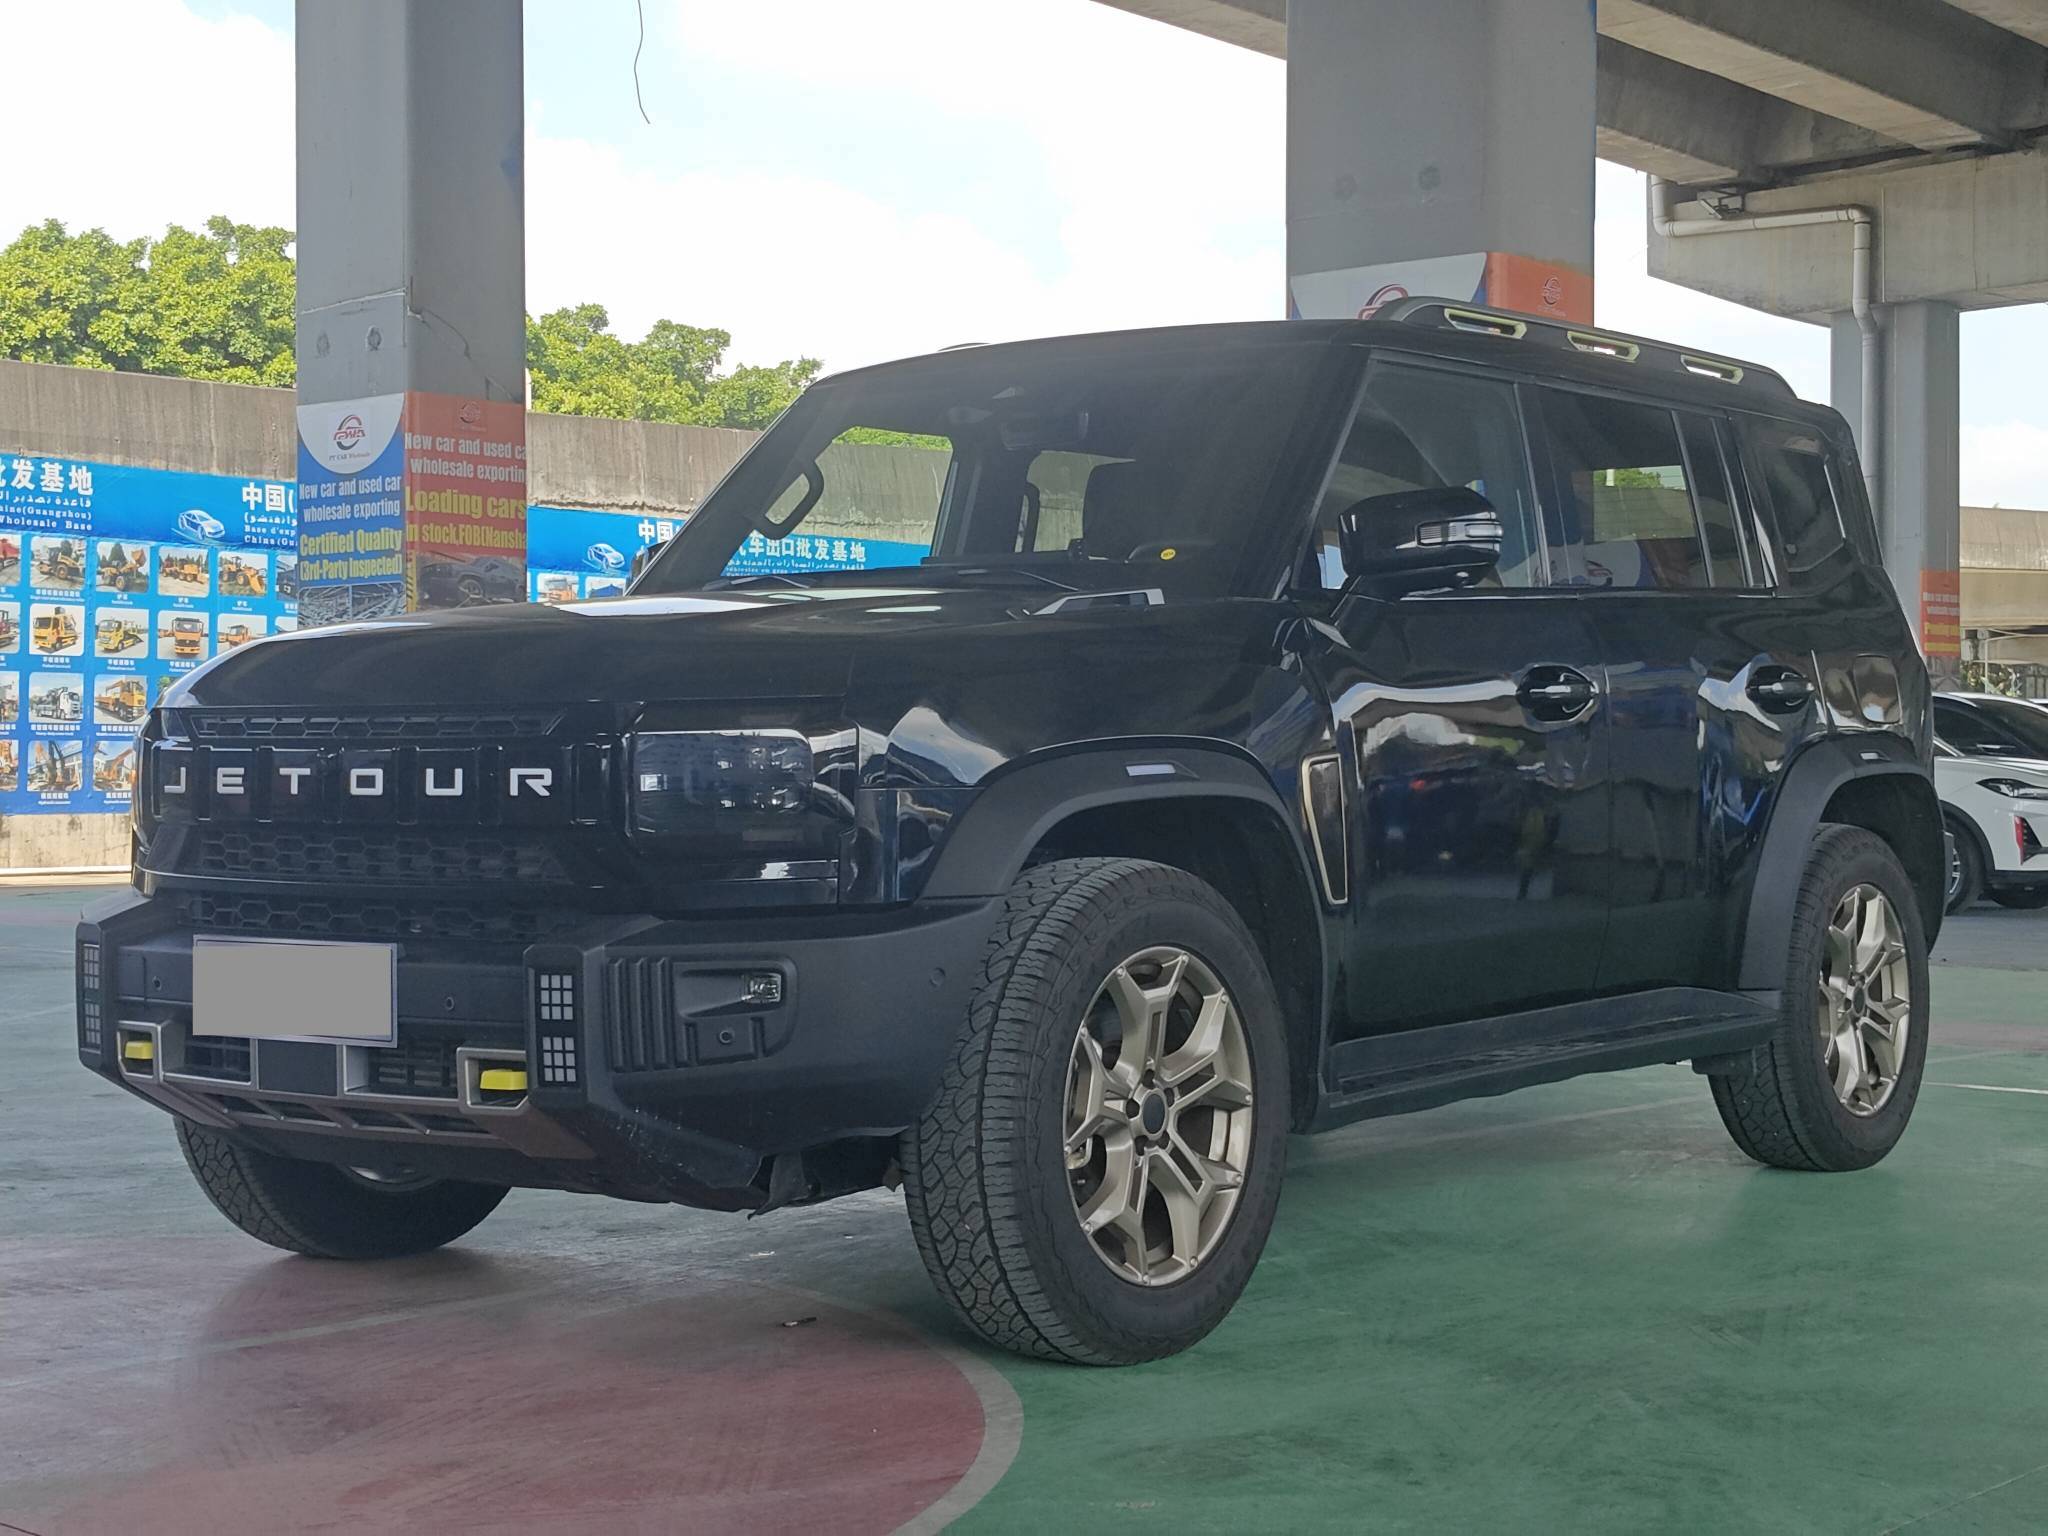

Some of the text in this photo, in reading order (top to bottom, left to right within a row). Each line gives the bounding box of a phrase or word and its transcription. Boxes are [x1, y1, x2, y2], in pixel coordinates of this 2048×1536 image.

[404, 432, 432, 450] New
[436, 437, 455, 453] car
[458, 439, 480, 456] and
[483, 442, 512, 459] used
[410, 457, 474, 479] wholesale
[242, 482, 297, 514] 中国(
[299, 476, 401, 500] New car and used car
[303, 498, 401, 523] wholesale exporting
[404, 486, 482, 520] Loading
[65, 520, 92, 531] Base
[244, 524, 267, 533] Base
[300, 527, 402, 556] Certified Quality
[163, 767, 552, 797] JETOUR
